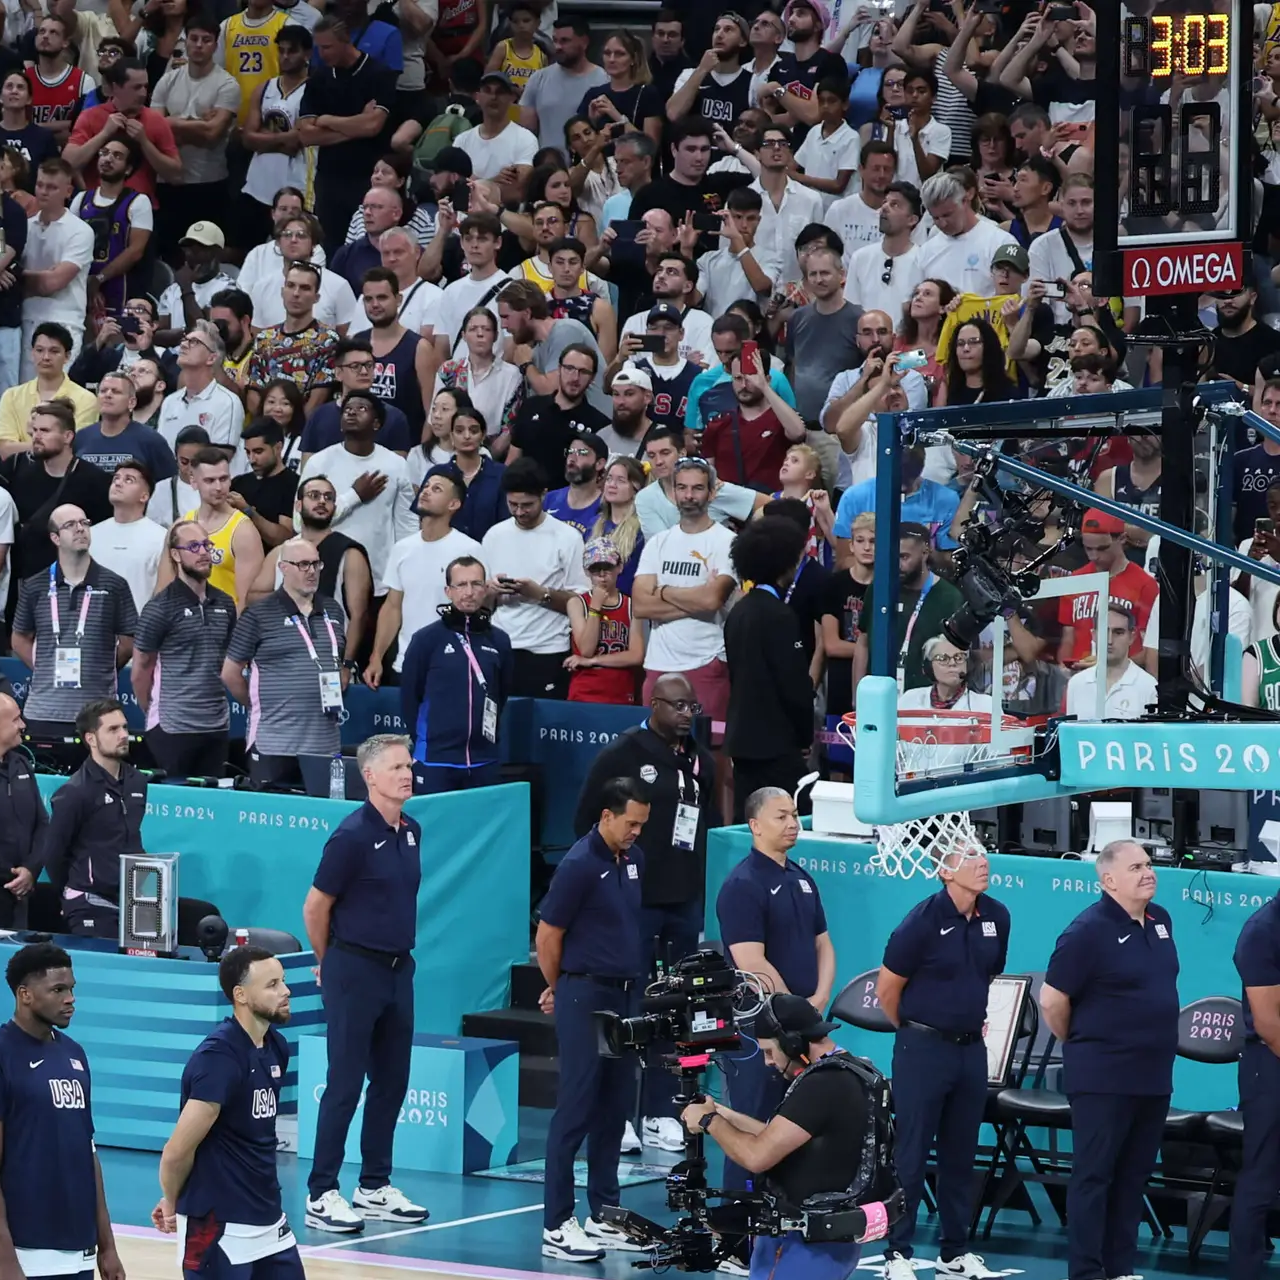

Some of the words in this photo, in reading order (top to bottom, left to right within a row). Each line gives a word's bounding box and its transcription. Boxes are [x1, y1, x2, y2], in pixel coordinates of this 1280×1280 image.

[231, 33, 272, 48] LAKERS
[1151, 13, 1230, 77] 3:03
[240, 52, 263, 73] 23
[31, 99, 76, 124] HEAT
[701, 97, 733, 122] USA
[1156, 251, 1237, 288] OMEGA
[661, 560, 702, 578] PUMA
[174, 805, 215, 821] 2024
[288, 815, 330, 832] 2024
[1189, 1025, 1232, 1041] 2024
[48, 1078, 86, 1109] USA
[251, 1086, 277, 1119] USA
[406, 1088, 448, 1108] ARIS
